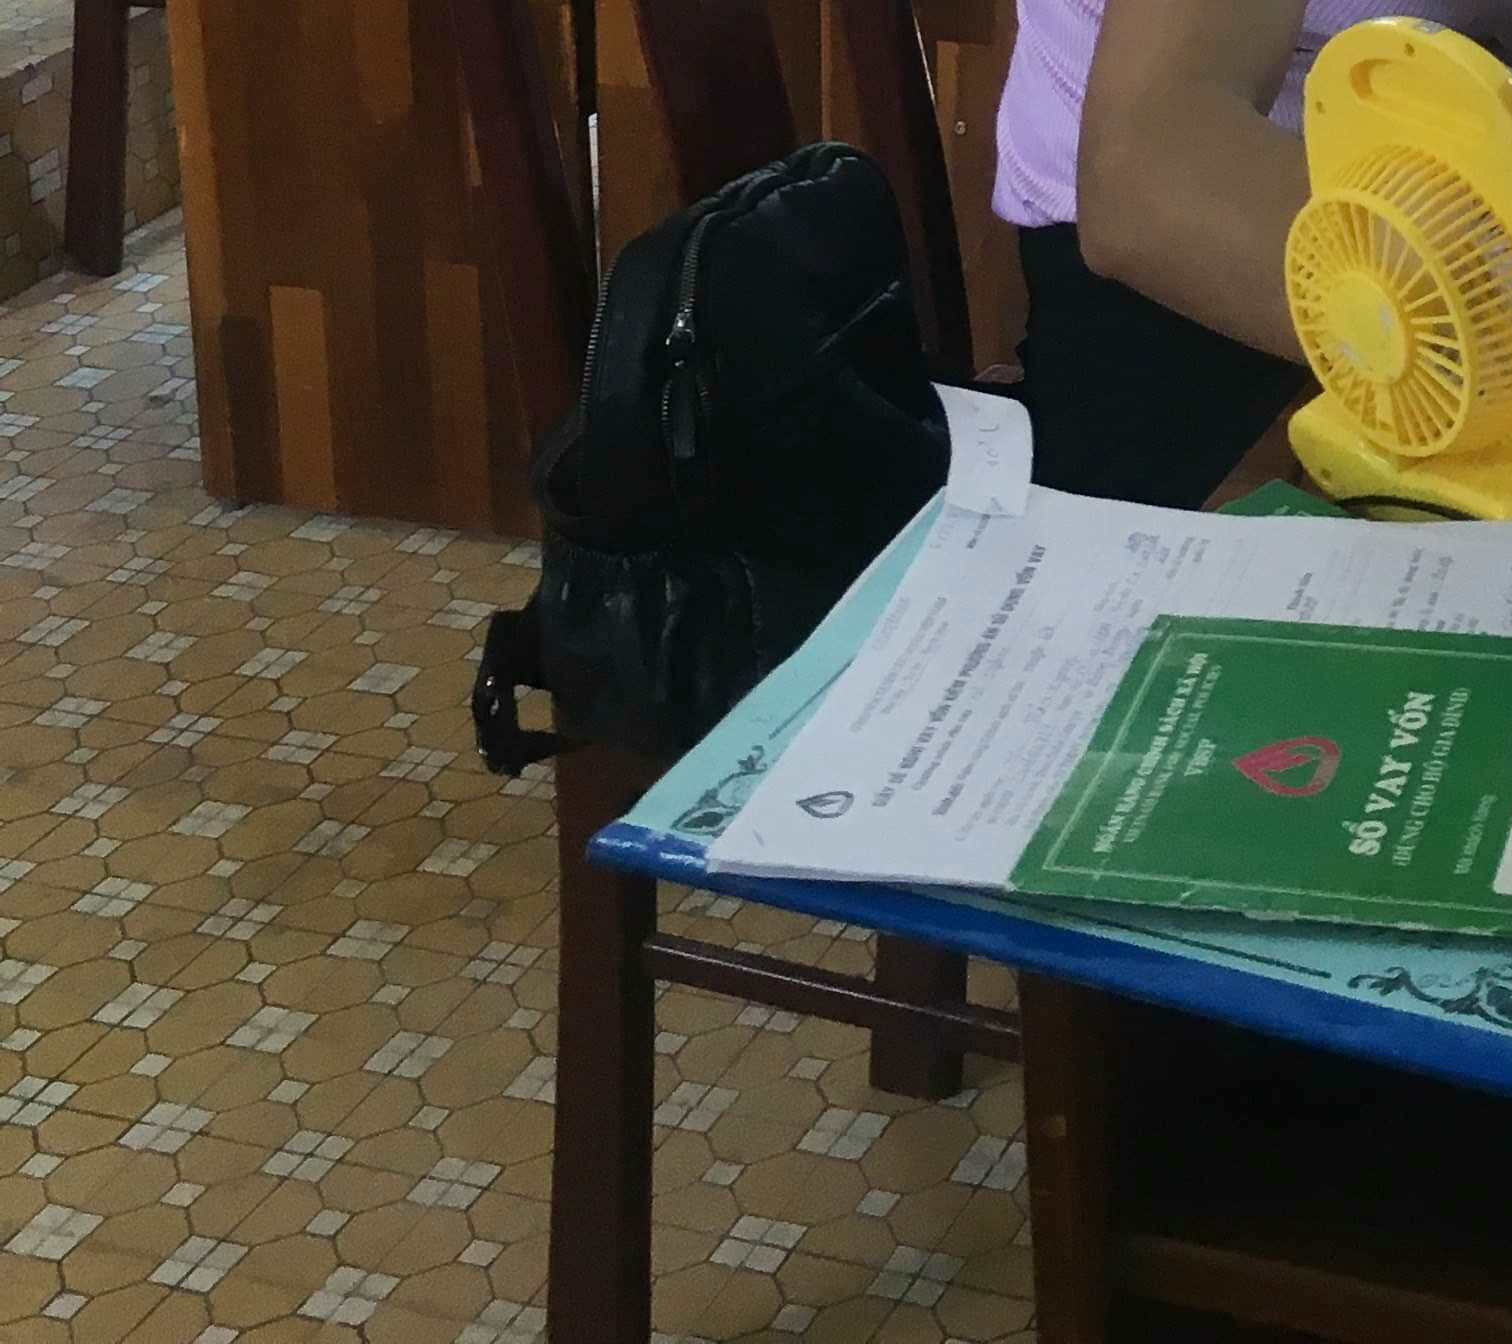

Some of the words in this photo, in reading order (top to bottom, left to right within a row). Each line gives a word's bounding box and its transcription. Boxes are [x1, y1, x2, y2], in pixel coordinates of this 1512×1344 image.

[1157, 697, 1186, 733] SÁCH
[1387, 691, 1436, 749] VỐN
[1364, 754, 1413, 814] VAY
[1341, 820, 1388, 856] SỔ
